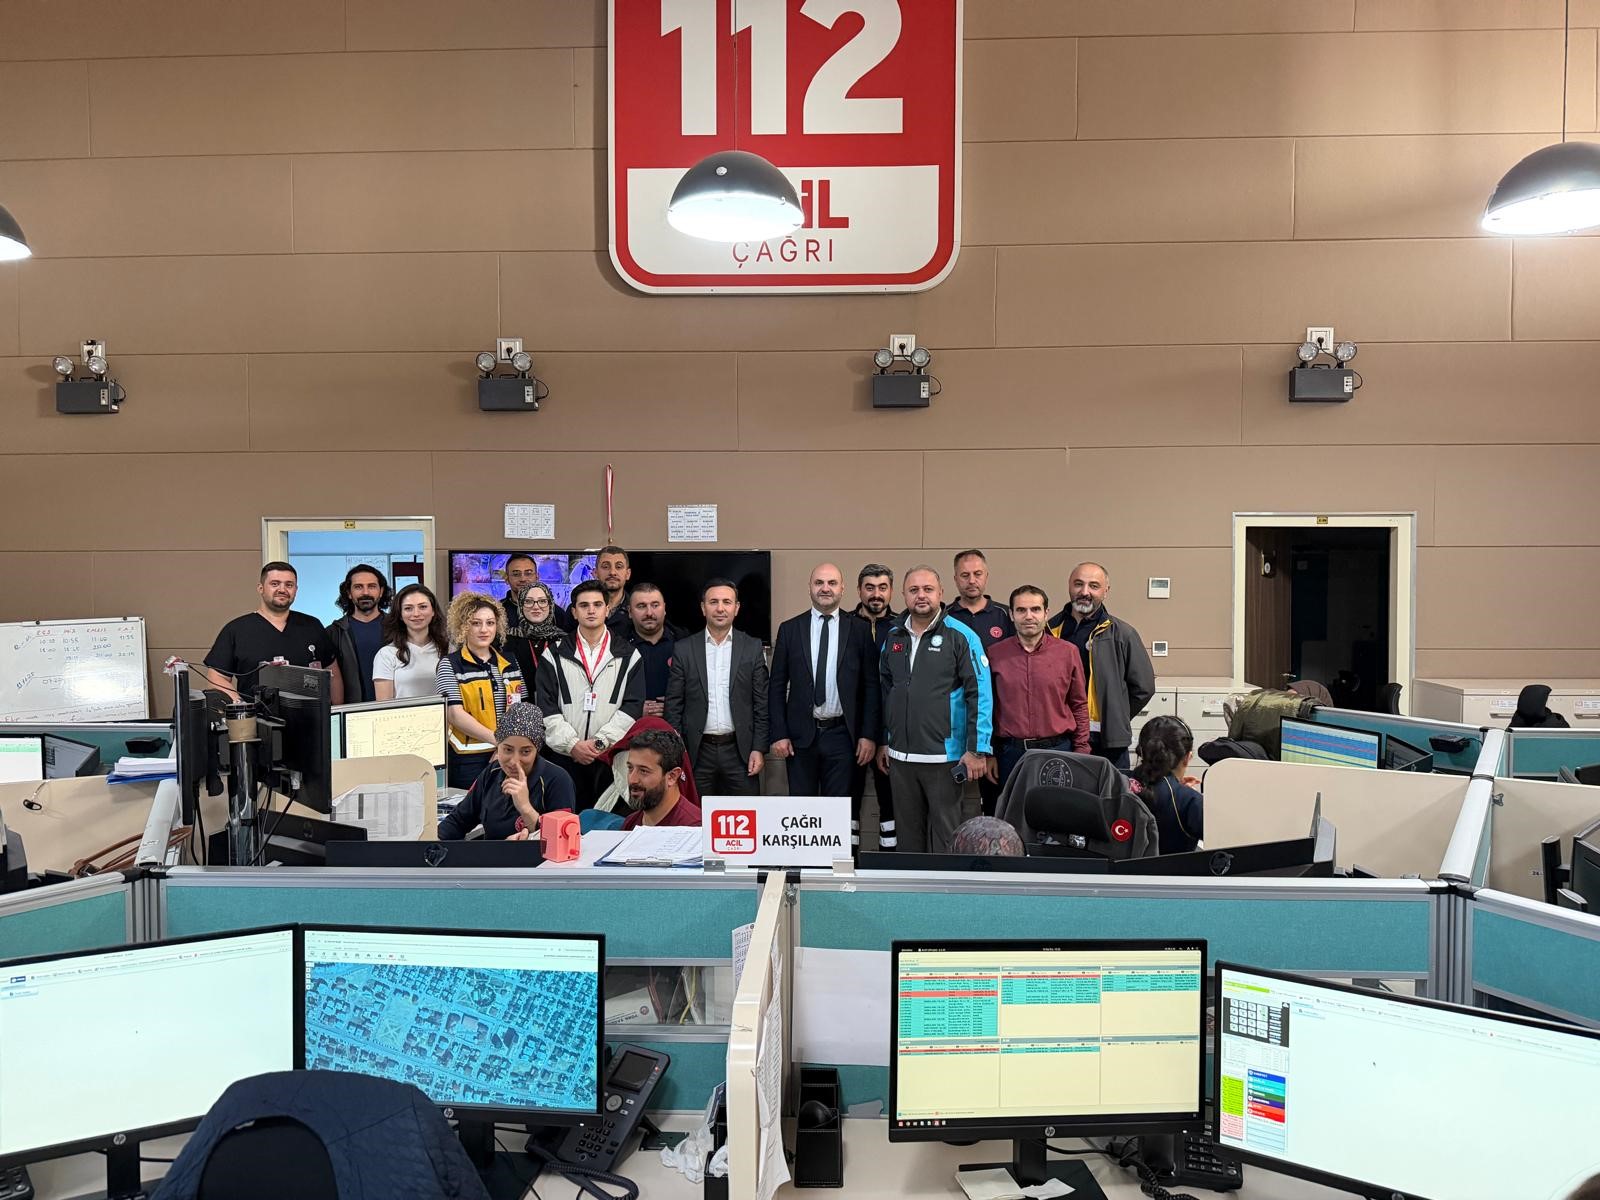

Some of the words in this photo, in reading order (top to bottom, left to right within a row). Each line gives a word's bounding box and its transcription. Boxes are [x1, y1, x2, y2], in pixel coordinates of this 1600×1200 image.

[661, 0, 904, 135] 112
[732, 236, 833, 269] ÇAĞRI
[717, 814, 750, 835] 112
[781, 814, 822, 831] ÇAĞRI
[762, 834, 842, 850] KARŞILAMA
